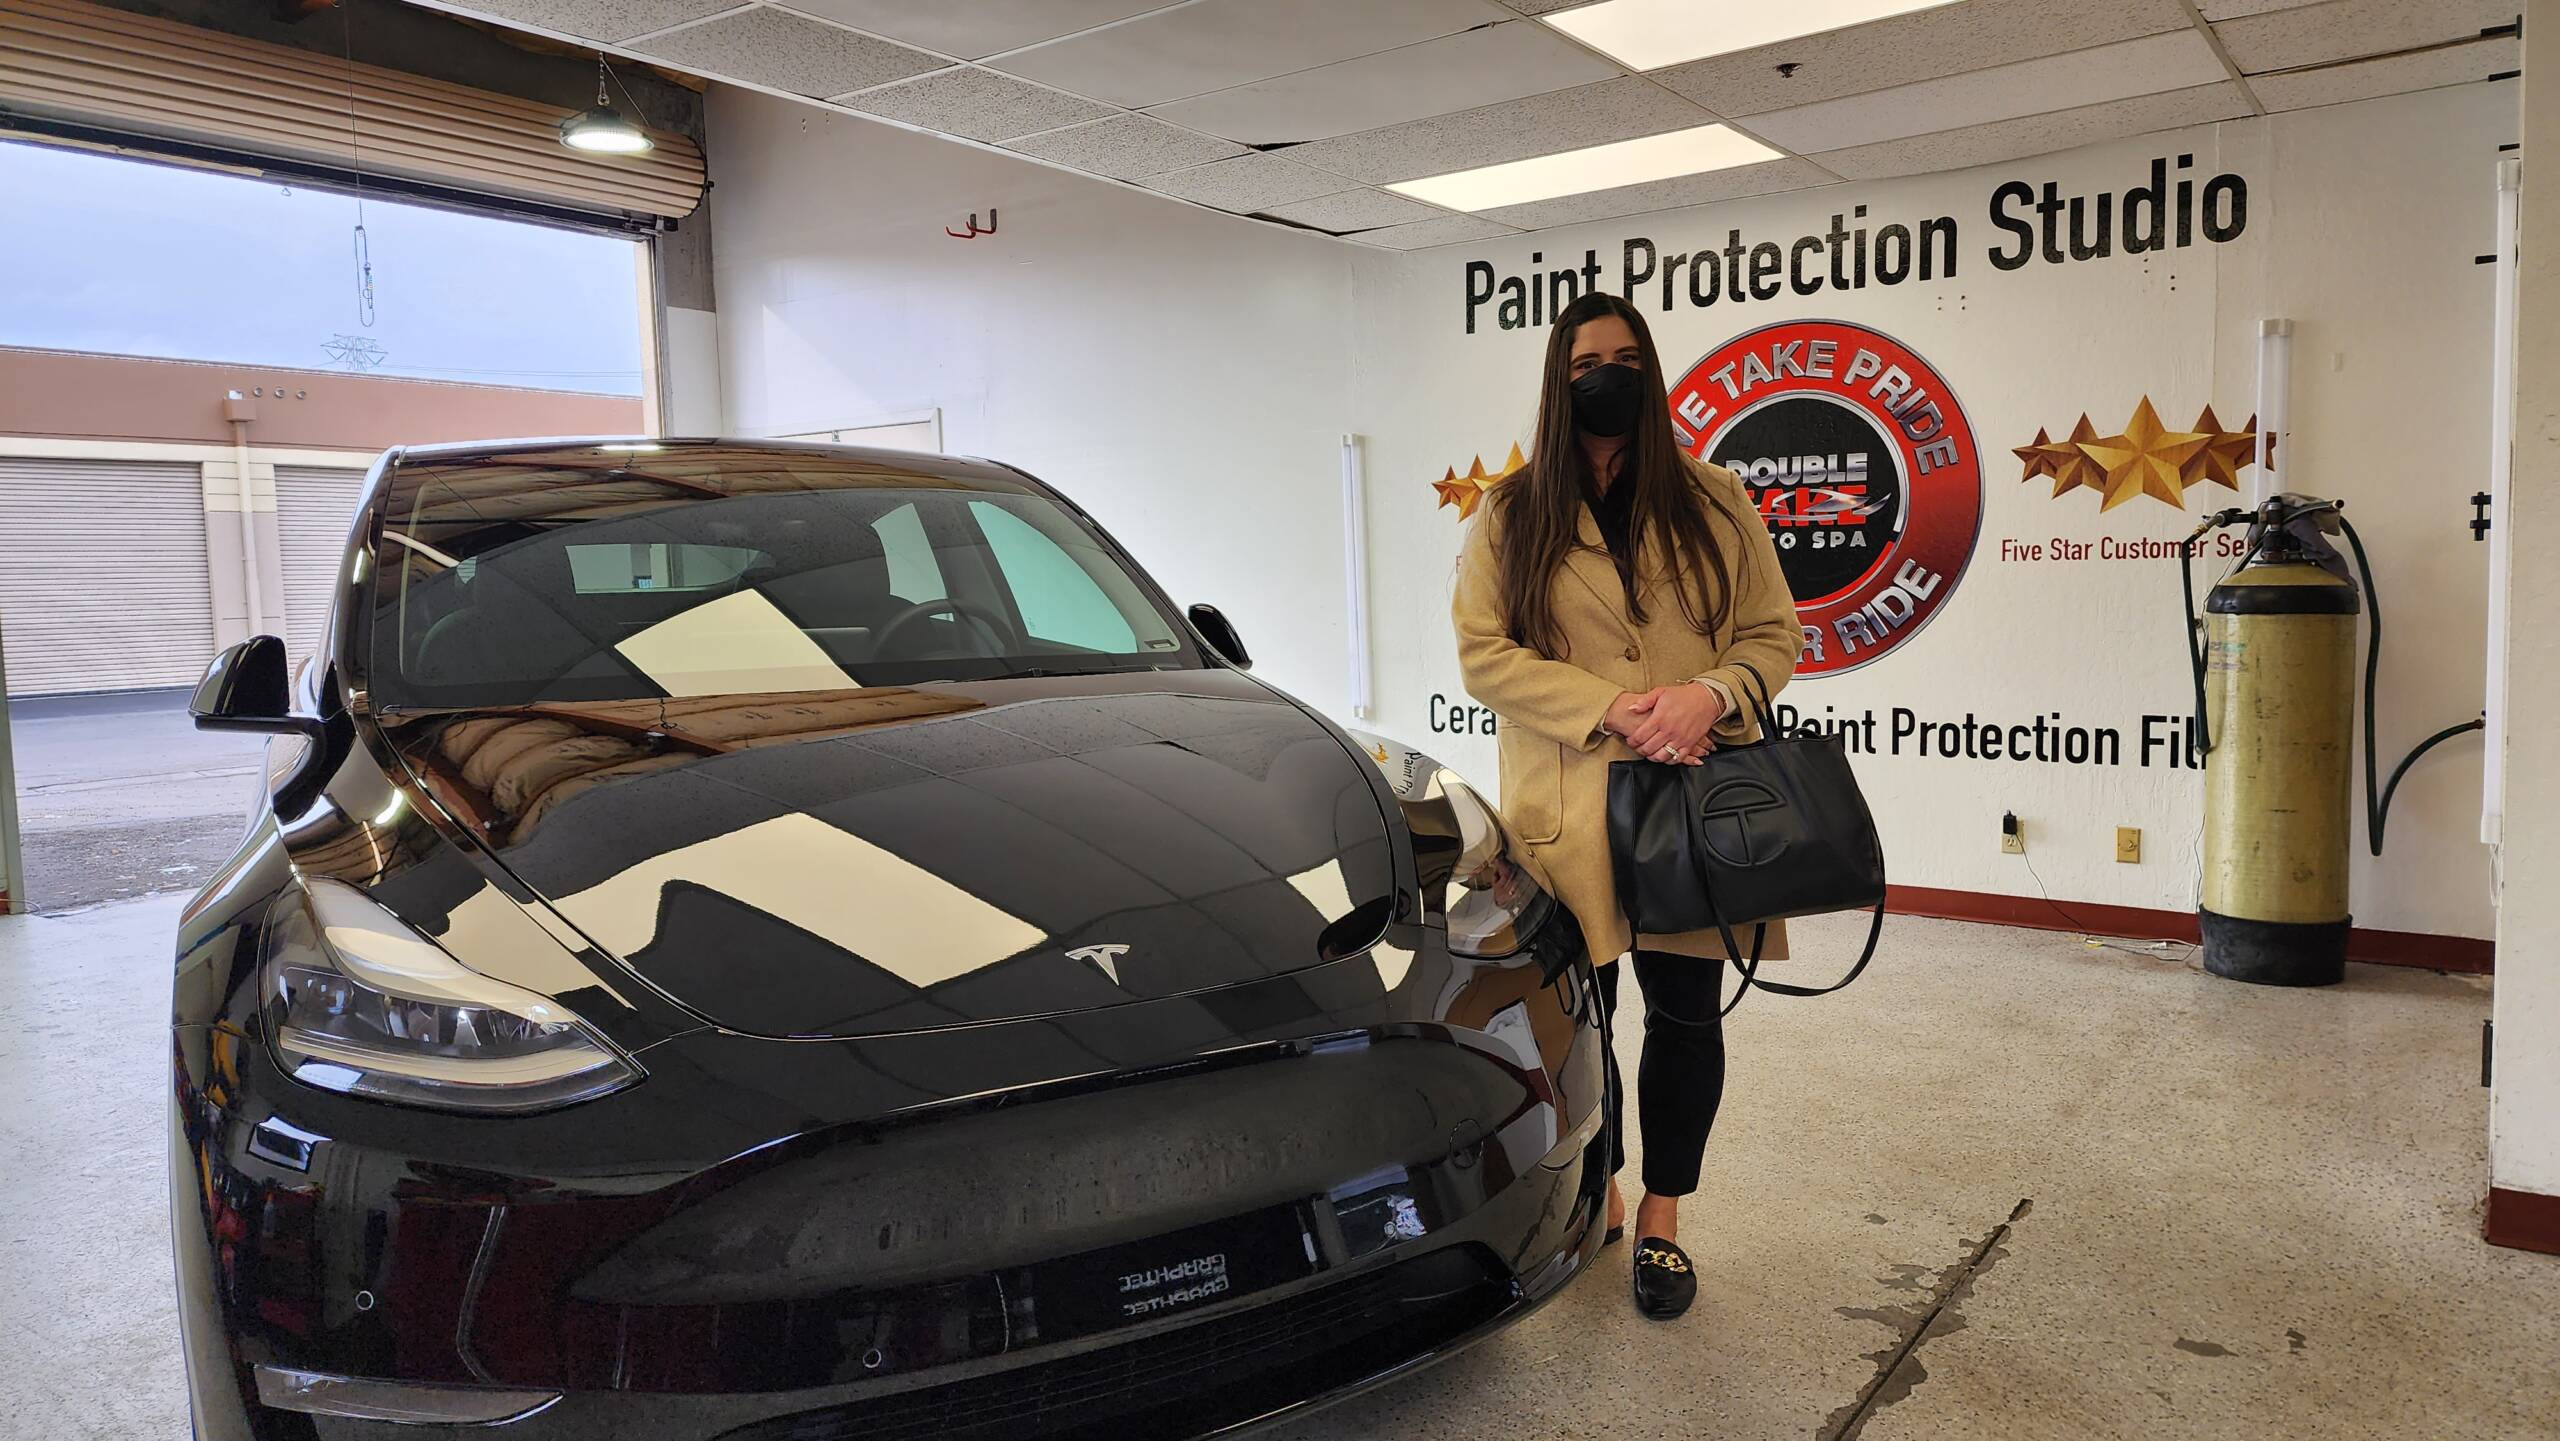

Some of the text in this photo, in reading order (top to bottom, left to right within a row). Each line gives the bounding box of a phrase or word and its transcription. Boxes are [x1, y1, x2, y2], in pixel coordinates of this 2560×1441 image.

[1465, 152, 2248, 335] Paint Protection Studio
[1708, 339, 1839, 401] TAKE
[1843, 347, 1960, 476] PRIDE
[1725, 452, 1868, 487] DOUBLE
[1746, 484, 1867, 527] AKE
[1811, 530, 1867, 549] SPA
[2001, 538, 2043, 562] Five
[2050, 537, 2094, 561] Star
[2100, 535, 2209, 560] Customer
[1831, 557, 1943, 655] RIDE
[1429, 693, 1497, 736] Cera
[1891, 707, 2120, 766] Protection
[2140, 714, 2207, 770] Fil
